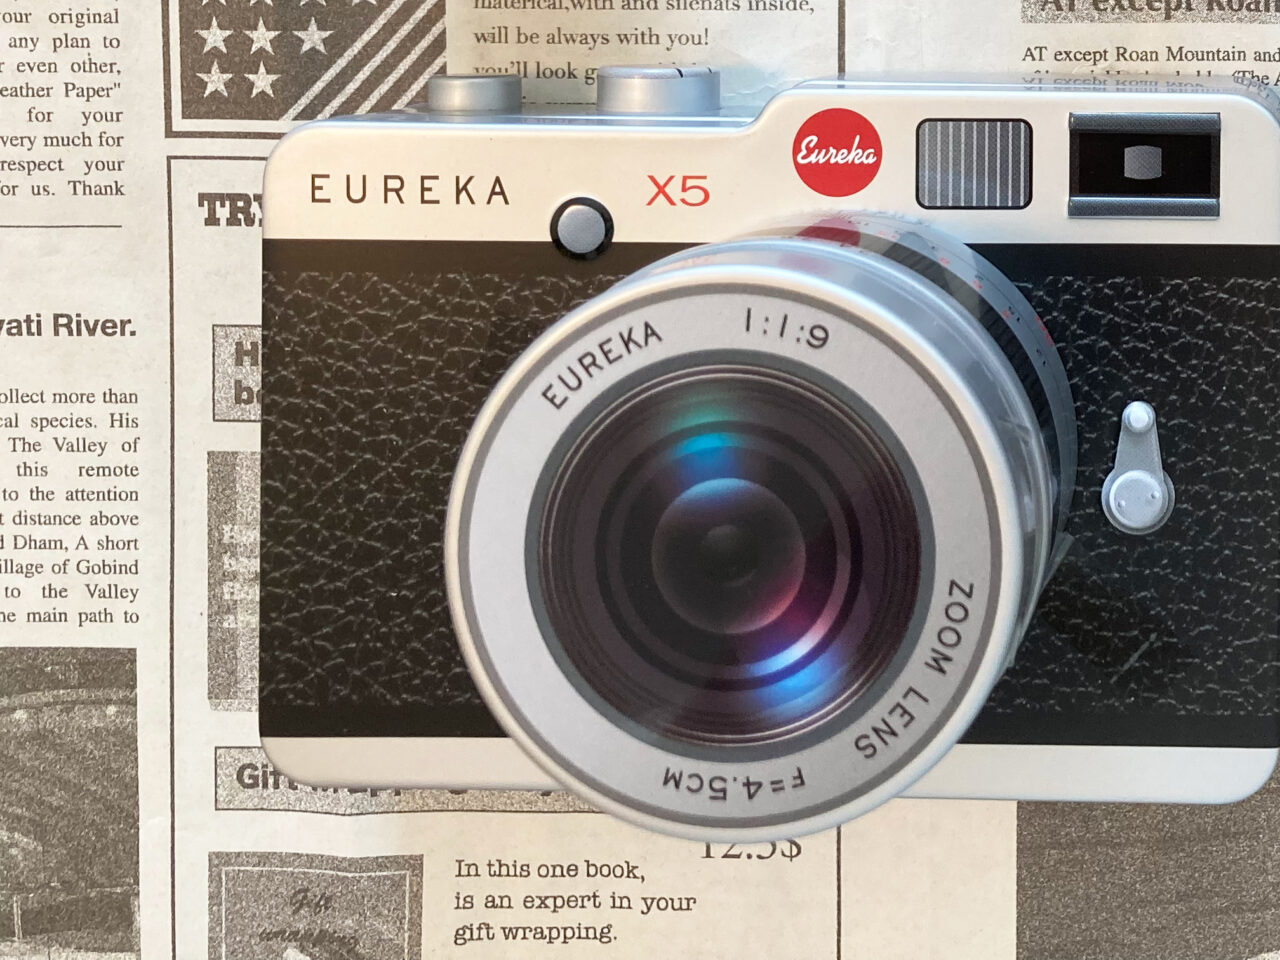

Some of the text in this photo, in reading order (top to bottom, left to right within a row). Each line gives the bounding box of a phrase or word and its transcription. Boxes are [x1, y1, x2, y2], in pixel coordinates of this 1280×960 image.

[474, 26, 708, 51] will be always with you!
[796, 135, 877, 167] Eureka
[311, 173, 711, 207] EUREKA X5
[53, 313, 136, 336] River.
[541, 321, 663, 410] EUREKA
[8, 437, 140, 457] The Valley of
[853, 579, 974, 760] ZOOM LENS
[455, 859, 644, 883] In this one book,
[455, 892, 696, 915] is an expert in your
[454, 923, 616, 945] gift wrapping.
